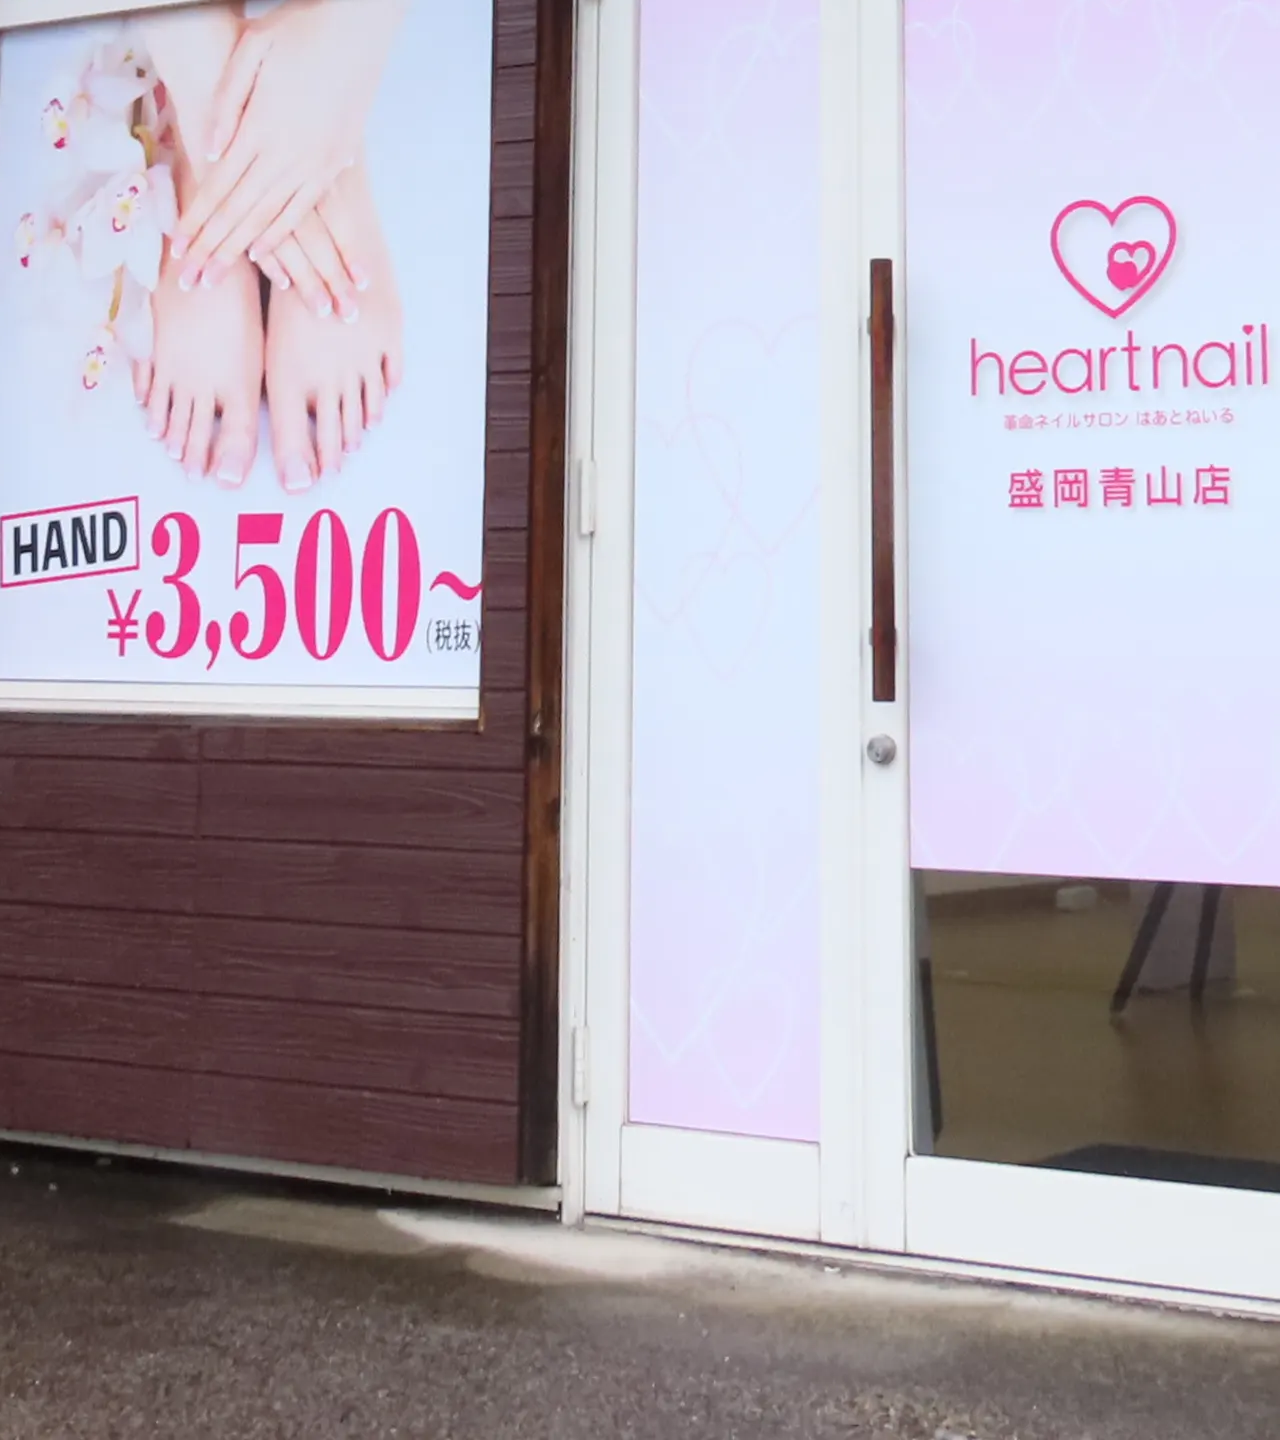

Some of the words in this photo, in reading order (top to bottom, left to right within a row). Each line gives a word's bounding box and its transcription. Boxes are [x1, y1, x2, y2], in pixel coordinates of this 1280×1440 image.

[971, 323, 1268, 396] heartnail
[1004, 413, 1128, 431] 革命ネイルサロン
[1136, 406, 1235, 426] はあとねいる
[1008, 464, 1231, 508] 盛岡青山店
[13, 510, 127, 576] HAND
[426, 618, 481, 655] (税抜)
